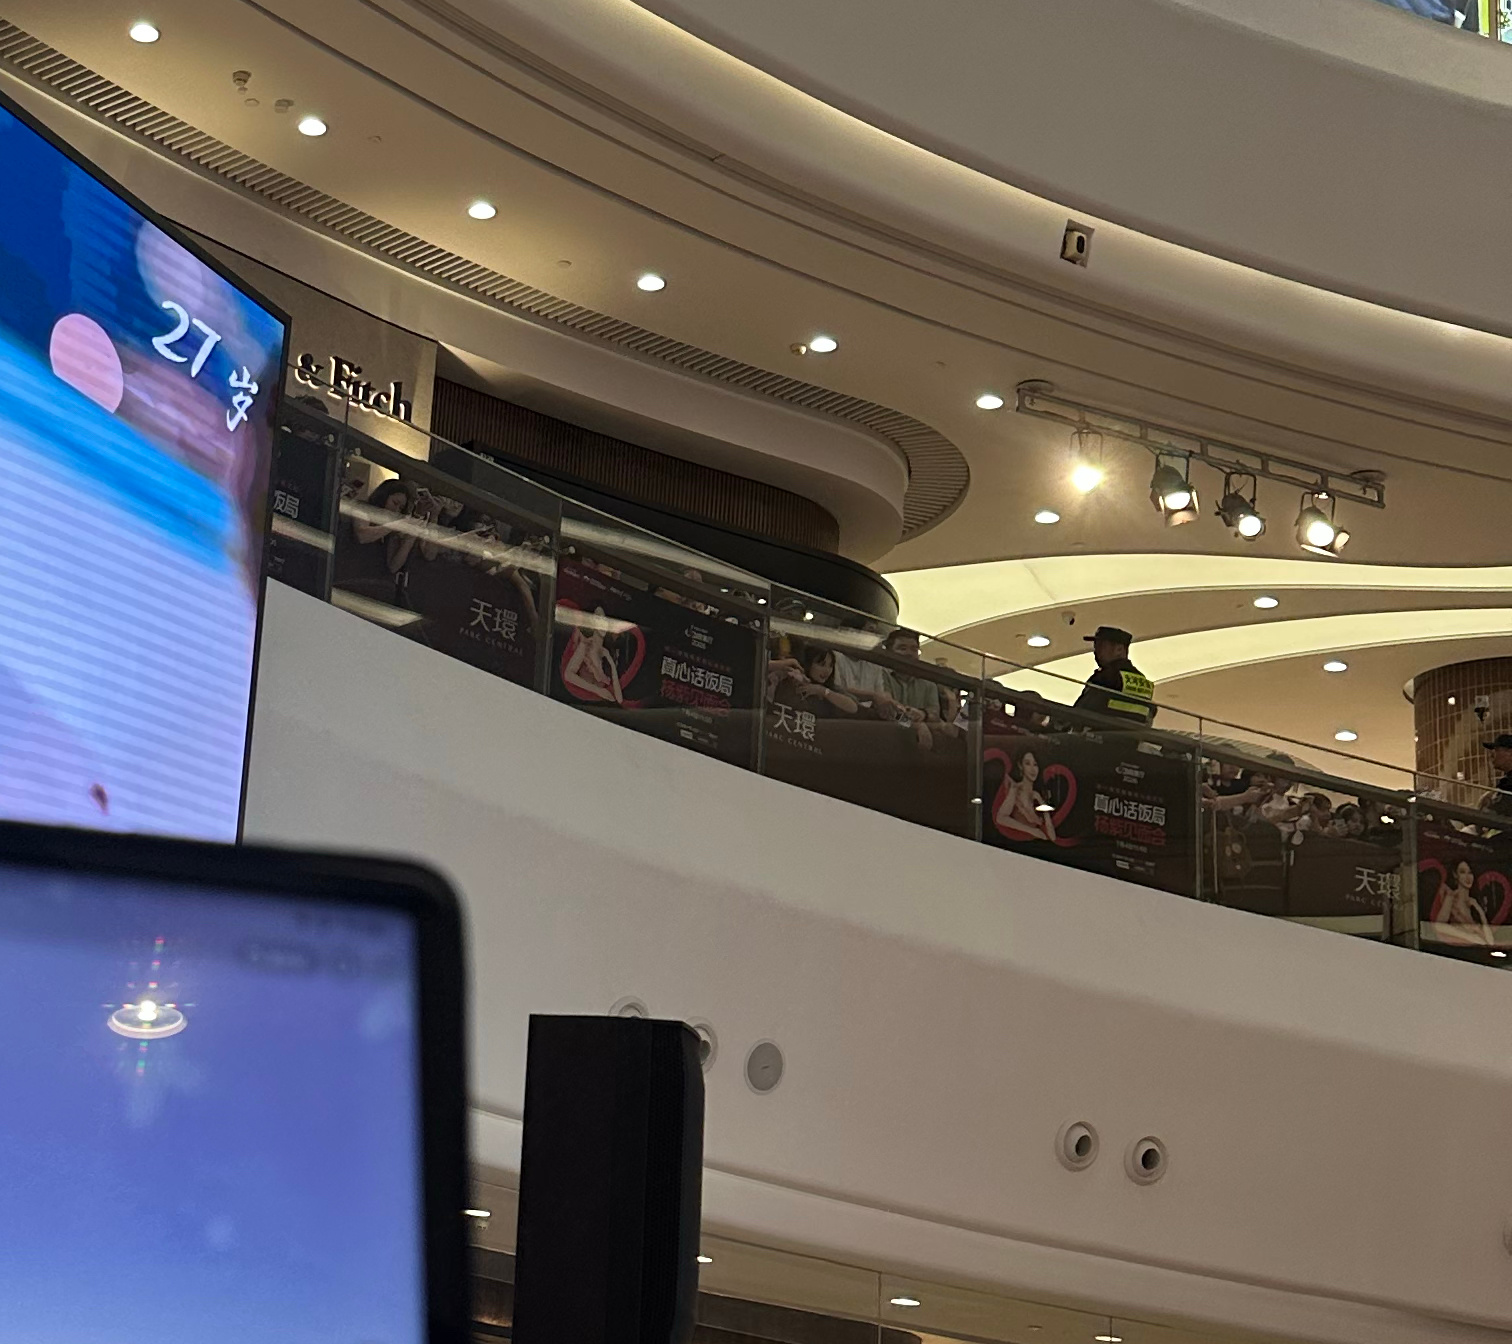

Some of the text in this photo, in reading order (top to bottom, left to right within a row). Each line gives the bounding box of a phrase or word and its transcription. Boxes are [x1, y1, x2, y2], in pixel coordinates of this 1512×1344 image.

[151, 300, 259, 432] 27 岁
[294, 353, 413, 424] & Fitch
[469, 597, 519, 642] 天環
[660, 655, 734, 697] 真心话饭局
[772, 701, 817, 742] 天環
[1093, 793, 1167, 827] 真心话饭局
